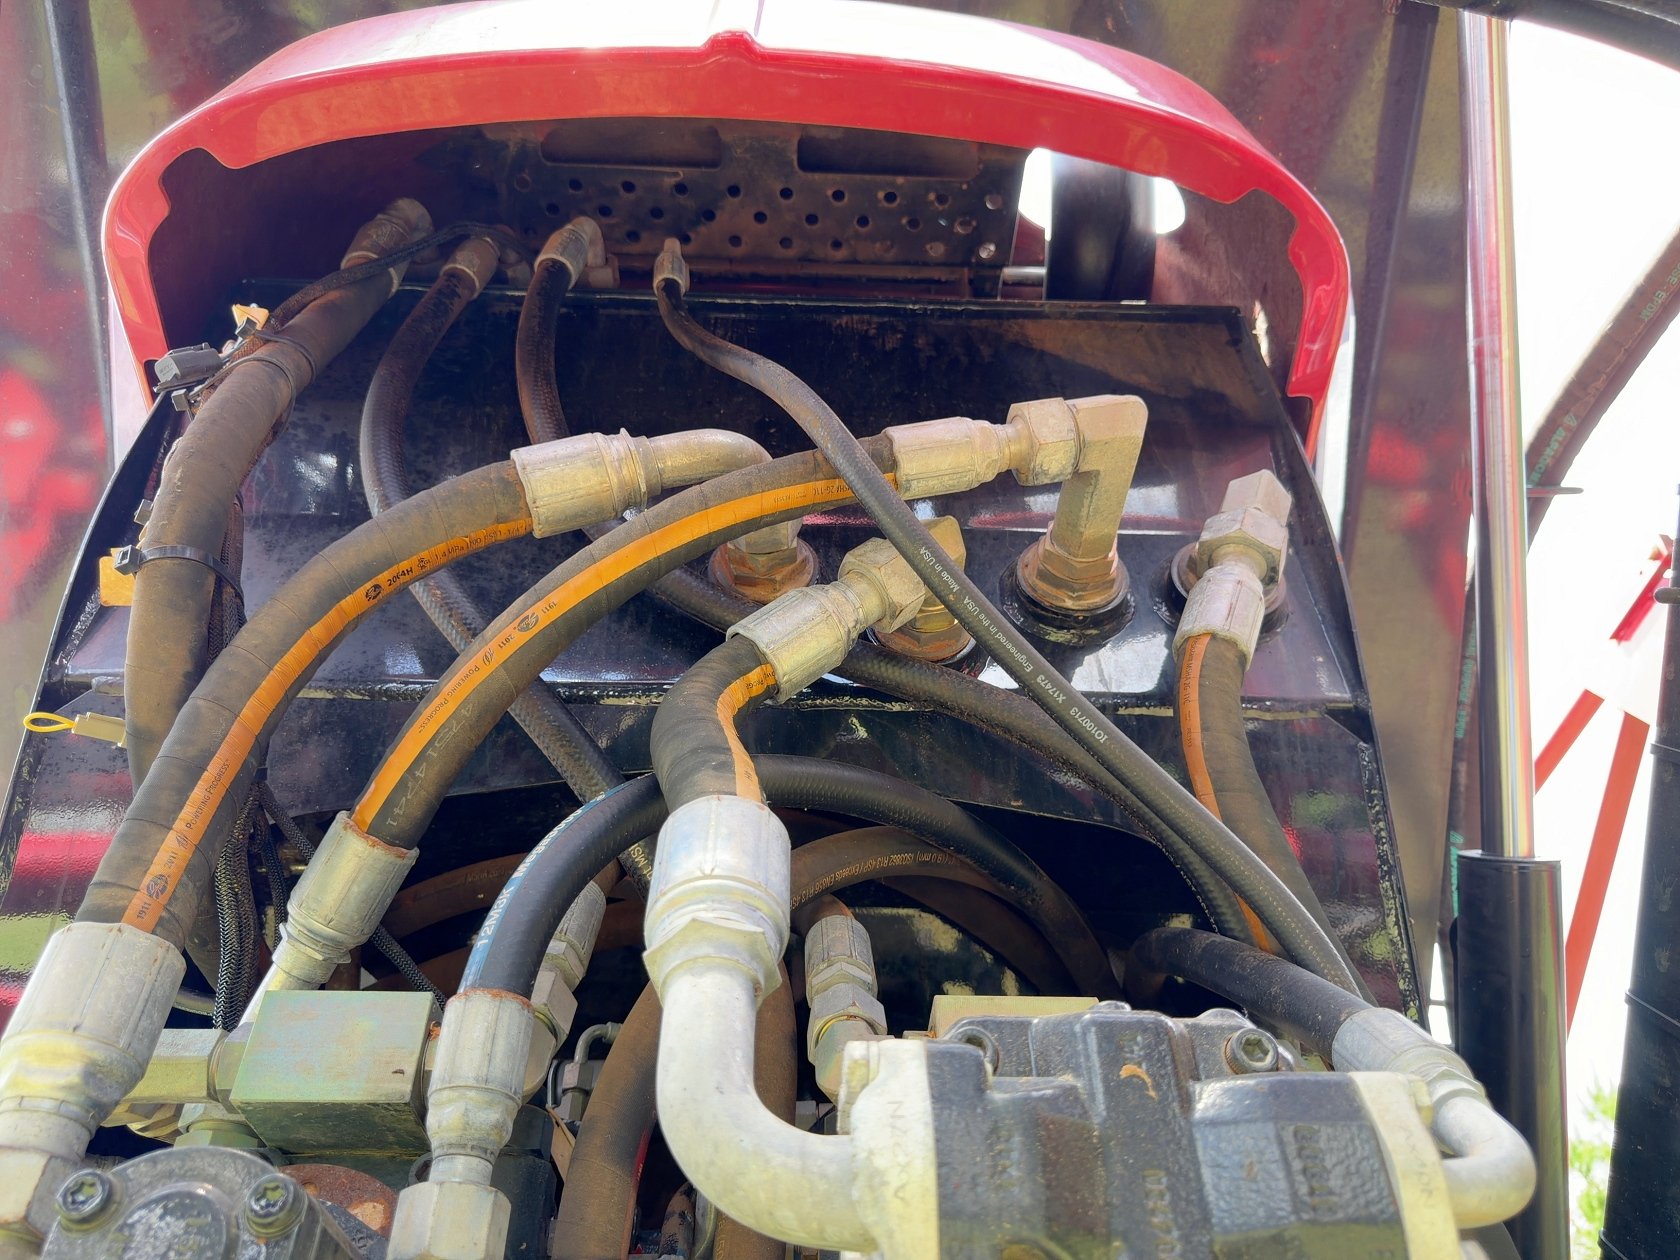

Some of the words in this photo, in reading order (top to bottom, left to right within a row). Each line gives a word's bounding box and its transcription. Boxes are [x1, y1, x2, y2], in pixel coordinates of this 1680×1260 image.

[919, 546, 936, 565] USA
[933, 563, 942, 572] in
[939, 570, 960, 592] Made
[540, 600, 557, 614] 1911
[962, 595, 980, 614] USA
[977, 612, 990, 626] the
[987, 624, 997, 634] in
[497, 633, 514, 648] 2011
[994, 632, 1033, 672] Engineered
[1035, 673, 1066, 704] X17473
[875, 856, 888, 868] R13
[135, 900, 151, 921] 1911
[163, 849, 179, 869] 2011
[476, 886, 514, 947] 12M3K
